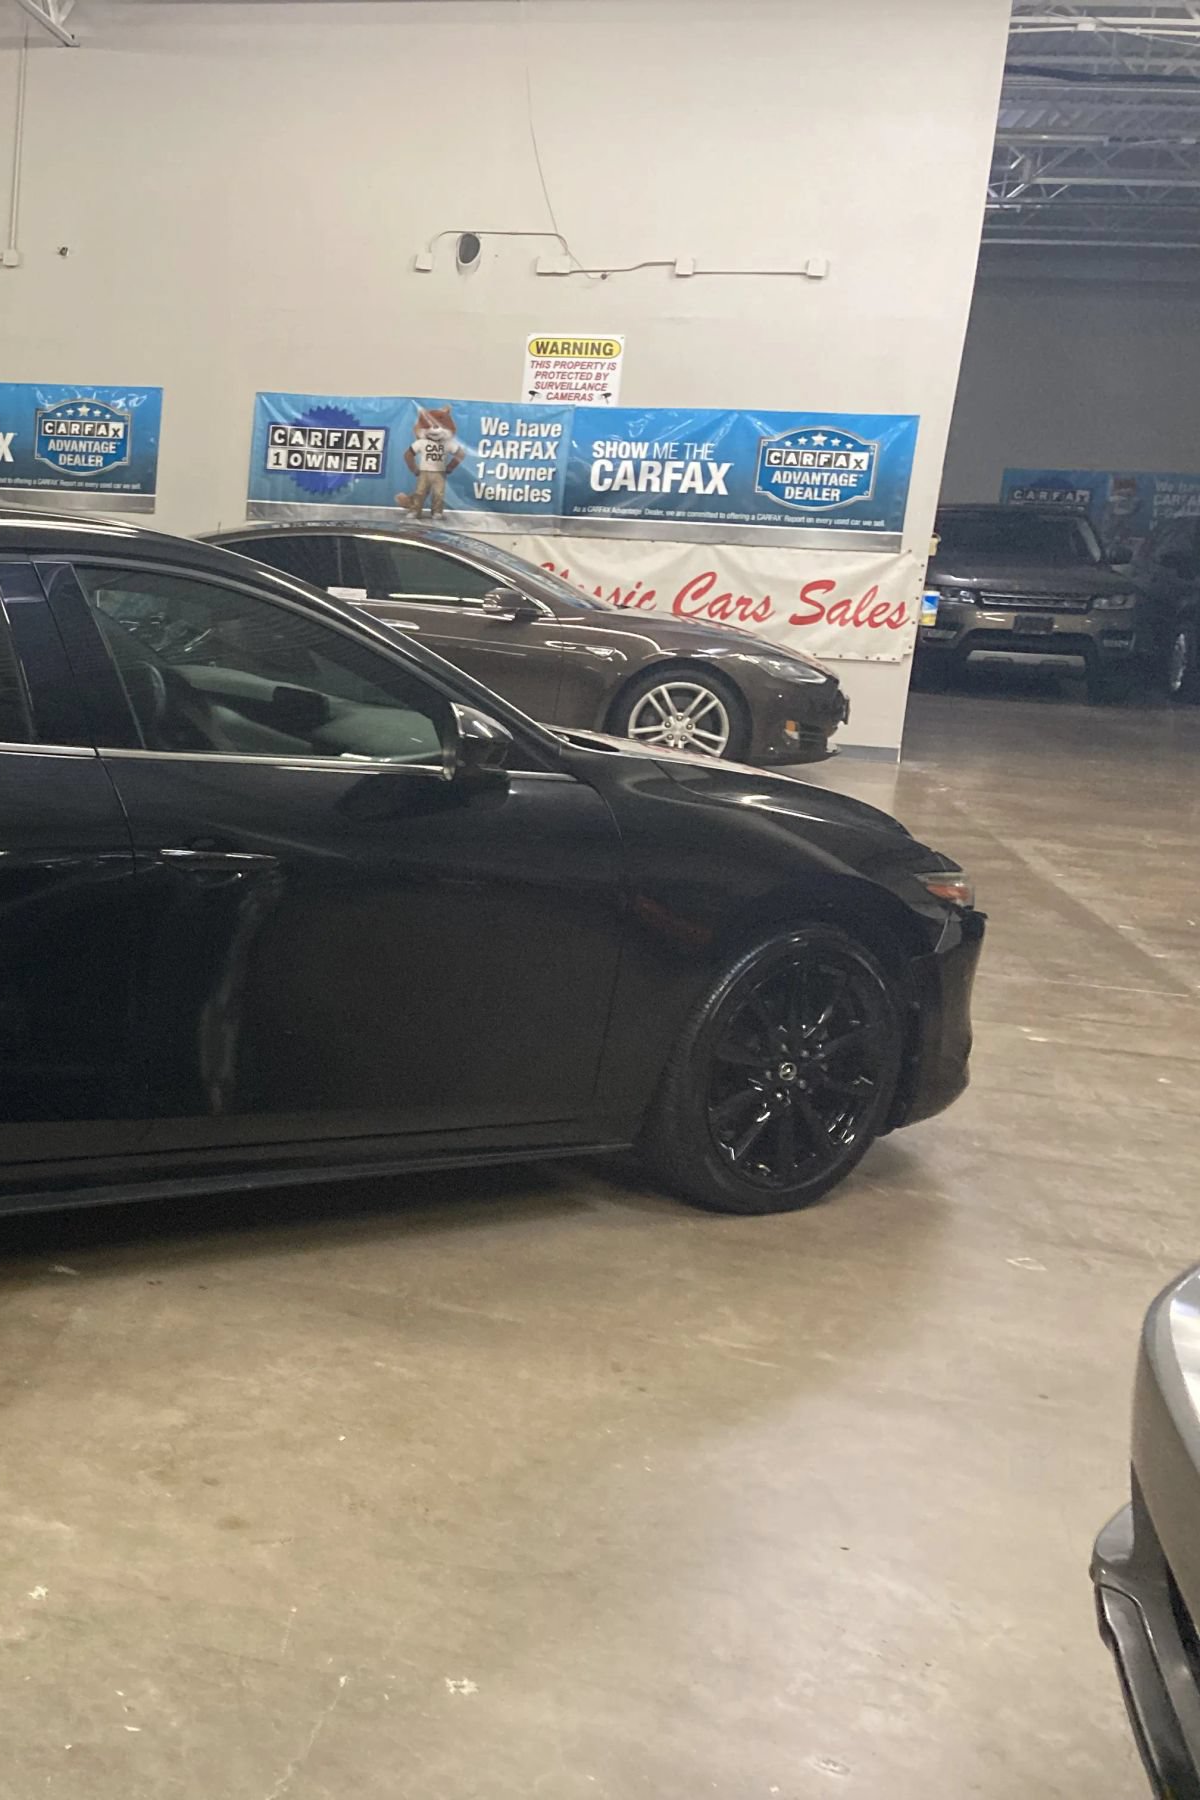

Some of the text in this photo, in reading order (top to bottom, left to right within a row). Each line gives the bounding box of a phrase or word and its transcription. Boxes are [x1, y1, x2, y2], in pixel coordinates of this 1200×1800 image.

[536, 341, 613, 356] WARNING
[531, 360, 551, 369] THIS
[553, 361, 606, 370] PROPERTY
[534, 371, 609, 381] PROTECTED BY
[534, 381, 608, 391] SURVEILLANCE
[546, 392, 594, 401] CAMERAS
[44, 422, 120, 438] CARFAX
[481, 418, 561, 437] We have
[48, 440, 117, 454] ADVANTAGE
[272, 428, 380, 451] CARFAX
[425, 444, 444, 452] CAR
[479, 440, 557, 460] CARFAX
[593, 441, 714, 460] SHOW ME THE
[59, 454, 103, 467] DEALER
[273, 451, 378, 472] 1 OWNER
[426, 452, 444, 462] FOX
[768, 451, 866, 470] CARFAX
[476, 463, 556, 481] 1-Owner
[591, 460, 731, 495] CARFAX
[773, 472, 857, 487] ADVANTAGE
[474, 483, 551, 503] Vehicles
[785, 486, 840, 502] DEALER
[672, 571, 774, 623] Cars
[789, 579, 911, 630] Sales
